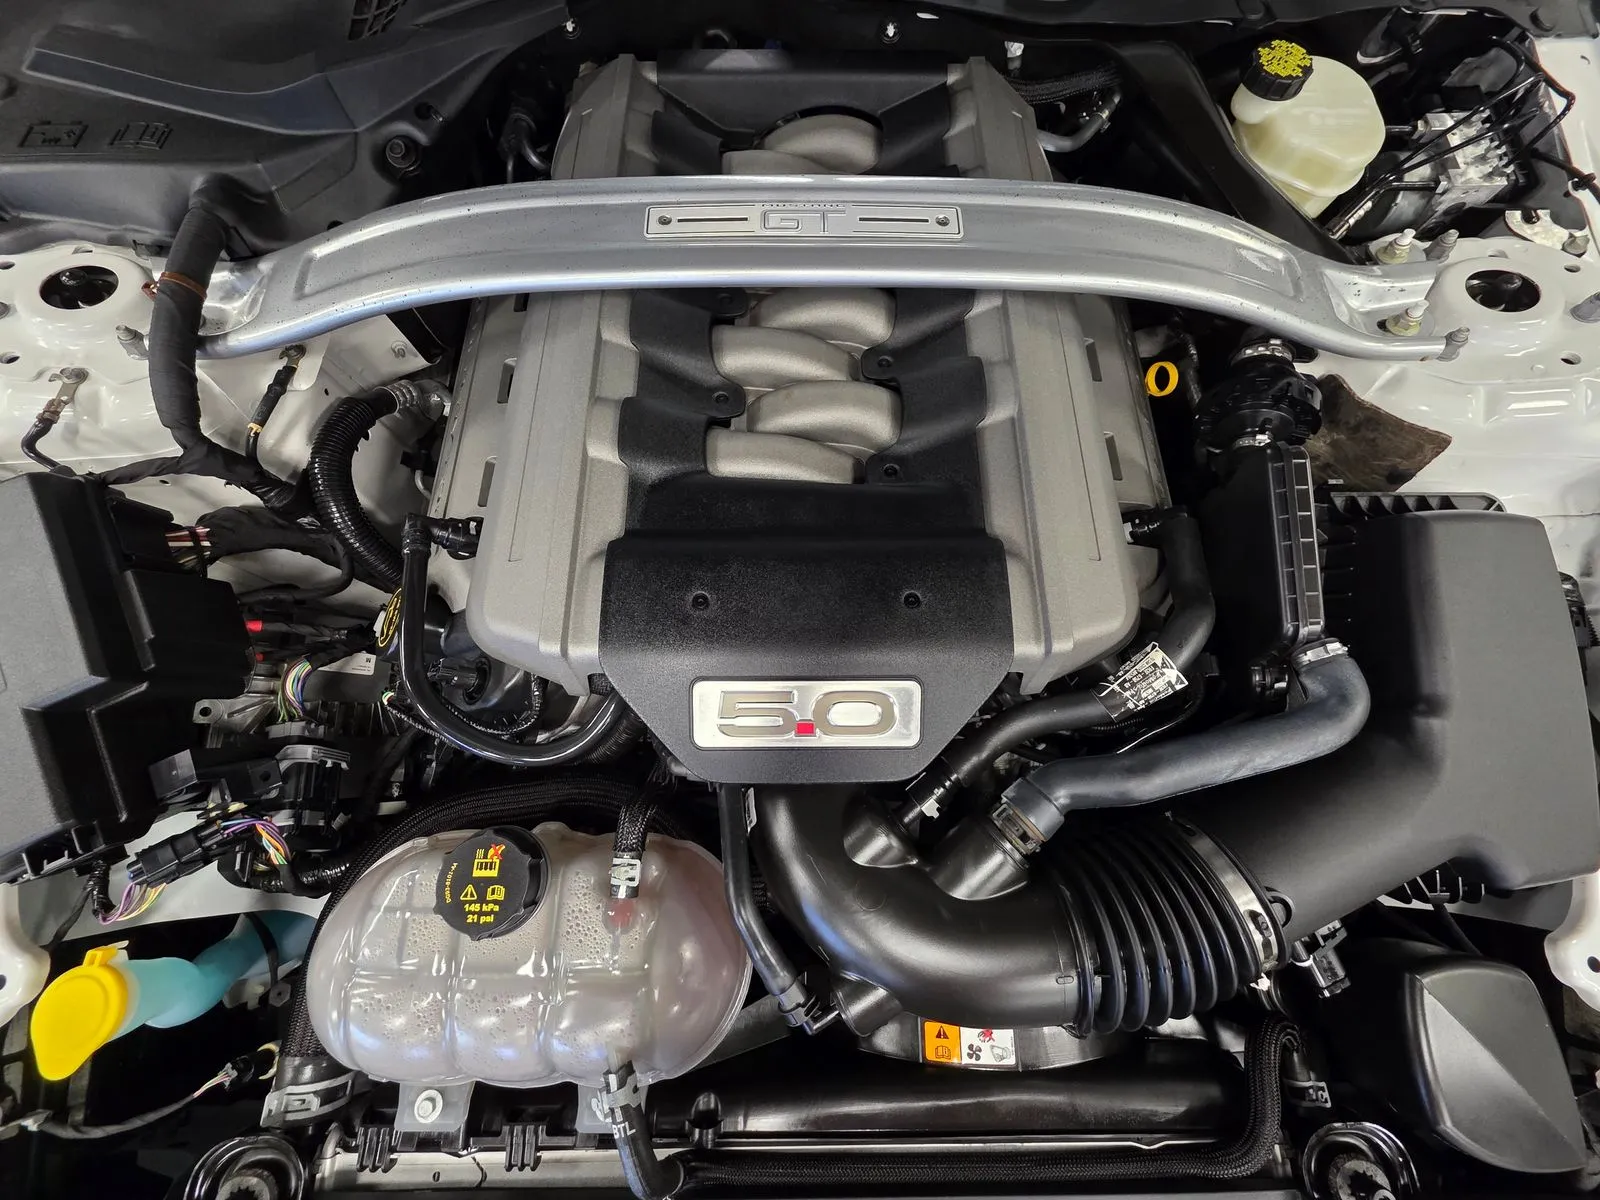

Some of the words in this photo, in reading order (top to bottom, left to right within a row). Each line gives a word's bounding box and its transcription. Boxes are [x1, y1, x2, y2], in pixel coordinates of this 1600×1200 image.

[760, 209, 846, 233] GT
[717, 690, 898, 738] 5.0
[464, 903, 480, 911] 145
[482, 903, 499, 911] kPa
[466, 914, 477, 922] 21
[480, 914, 494, 924] psi
[612, 1121, 636, 1139] BTL
